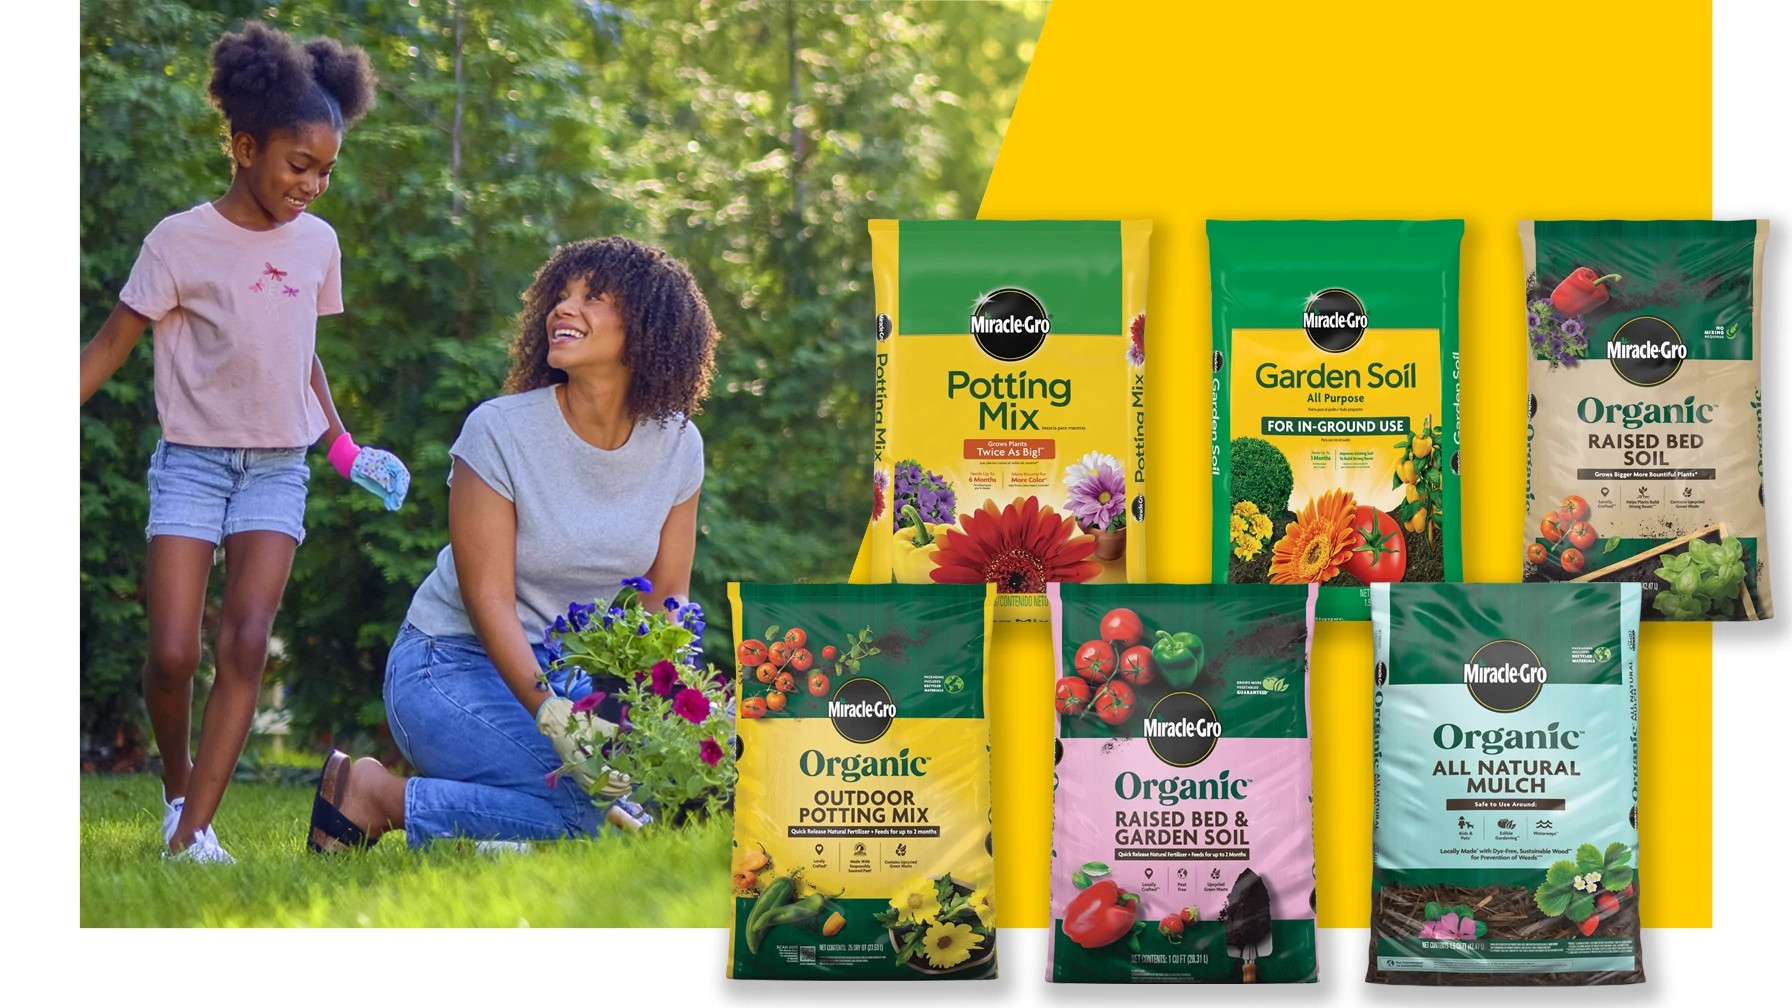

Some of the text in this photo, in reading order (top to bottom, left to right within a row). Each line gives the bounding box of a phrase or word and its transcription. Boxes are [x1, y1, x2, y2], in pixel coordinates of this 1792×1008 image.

[1256, 363, 1416, 389] Garden Soil
[948, 370, 1071, 407] Potting
[1132, 374, 1144, 407] Mix
[1307, 393, 1364, 405] All Purpose
[979, 402, 1039, 430] Mix
[1268, 420, 1404, 432] FOR IN-GROUND USE
[875, 428, 887, 461] Mix
[1588, 434, 1704, 449] RAISED BED
[977, 448, 1005, 457] Twice
[1008, 448, 1020, 457] As
[1624, 451, 1669, 466] SOIL
[1360, 588, 1370, 597] NET
[1433, 760, 1580, 776] ALL NATURAL
[1467, 778, 1546, 793] MULCH
[814, 790, 914, 805] OUTDOOR
[800, 808, 929, 823] POTTING MIX
[1116, 811, 1248, 827] RAISED BED &
[1115, 829, 1249, 845] GARDEN SOIL
[1168, 954, 1171, 963] 1
